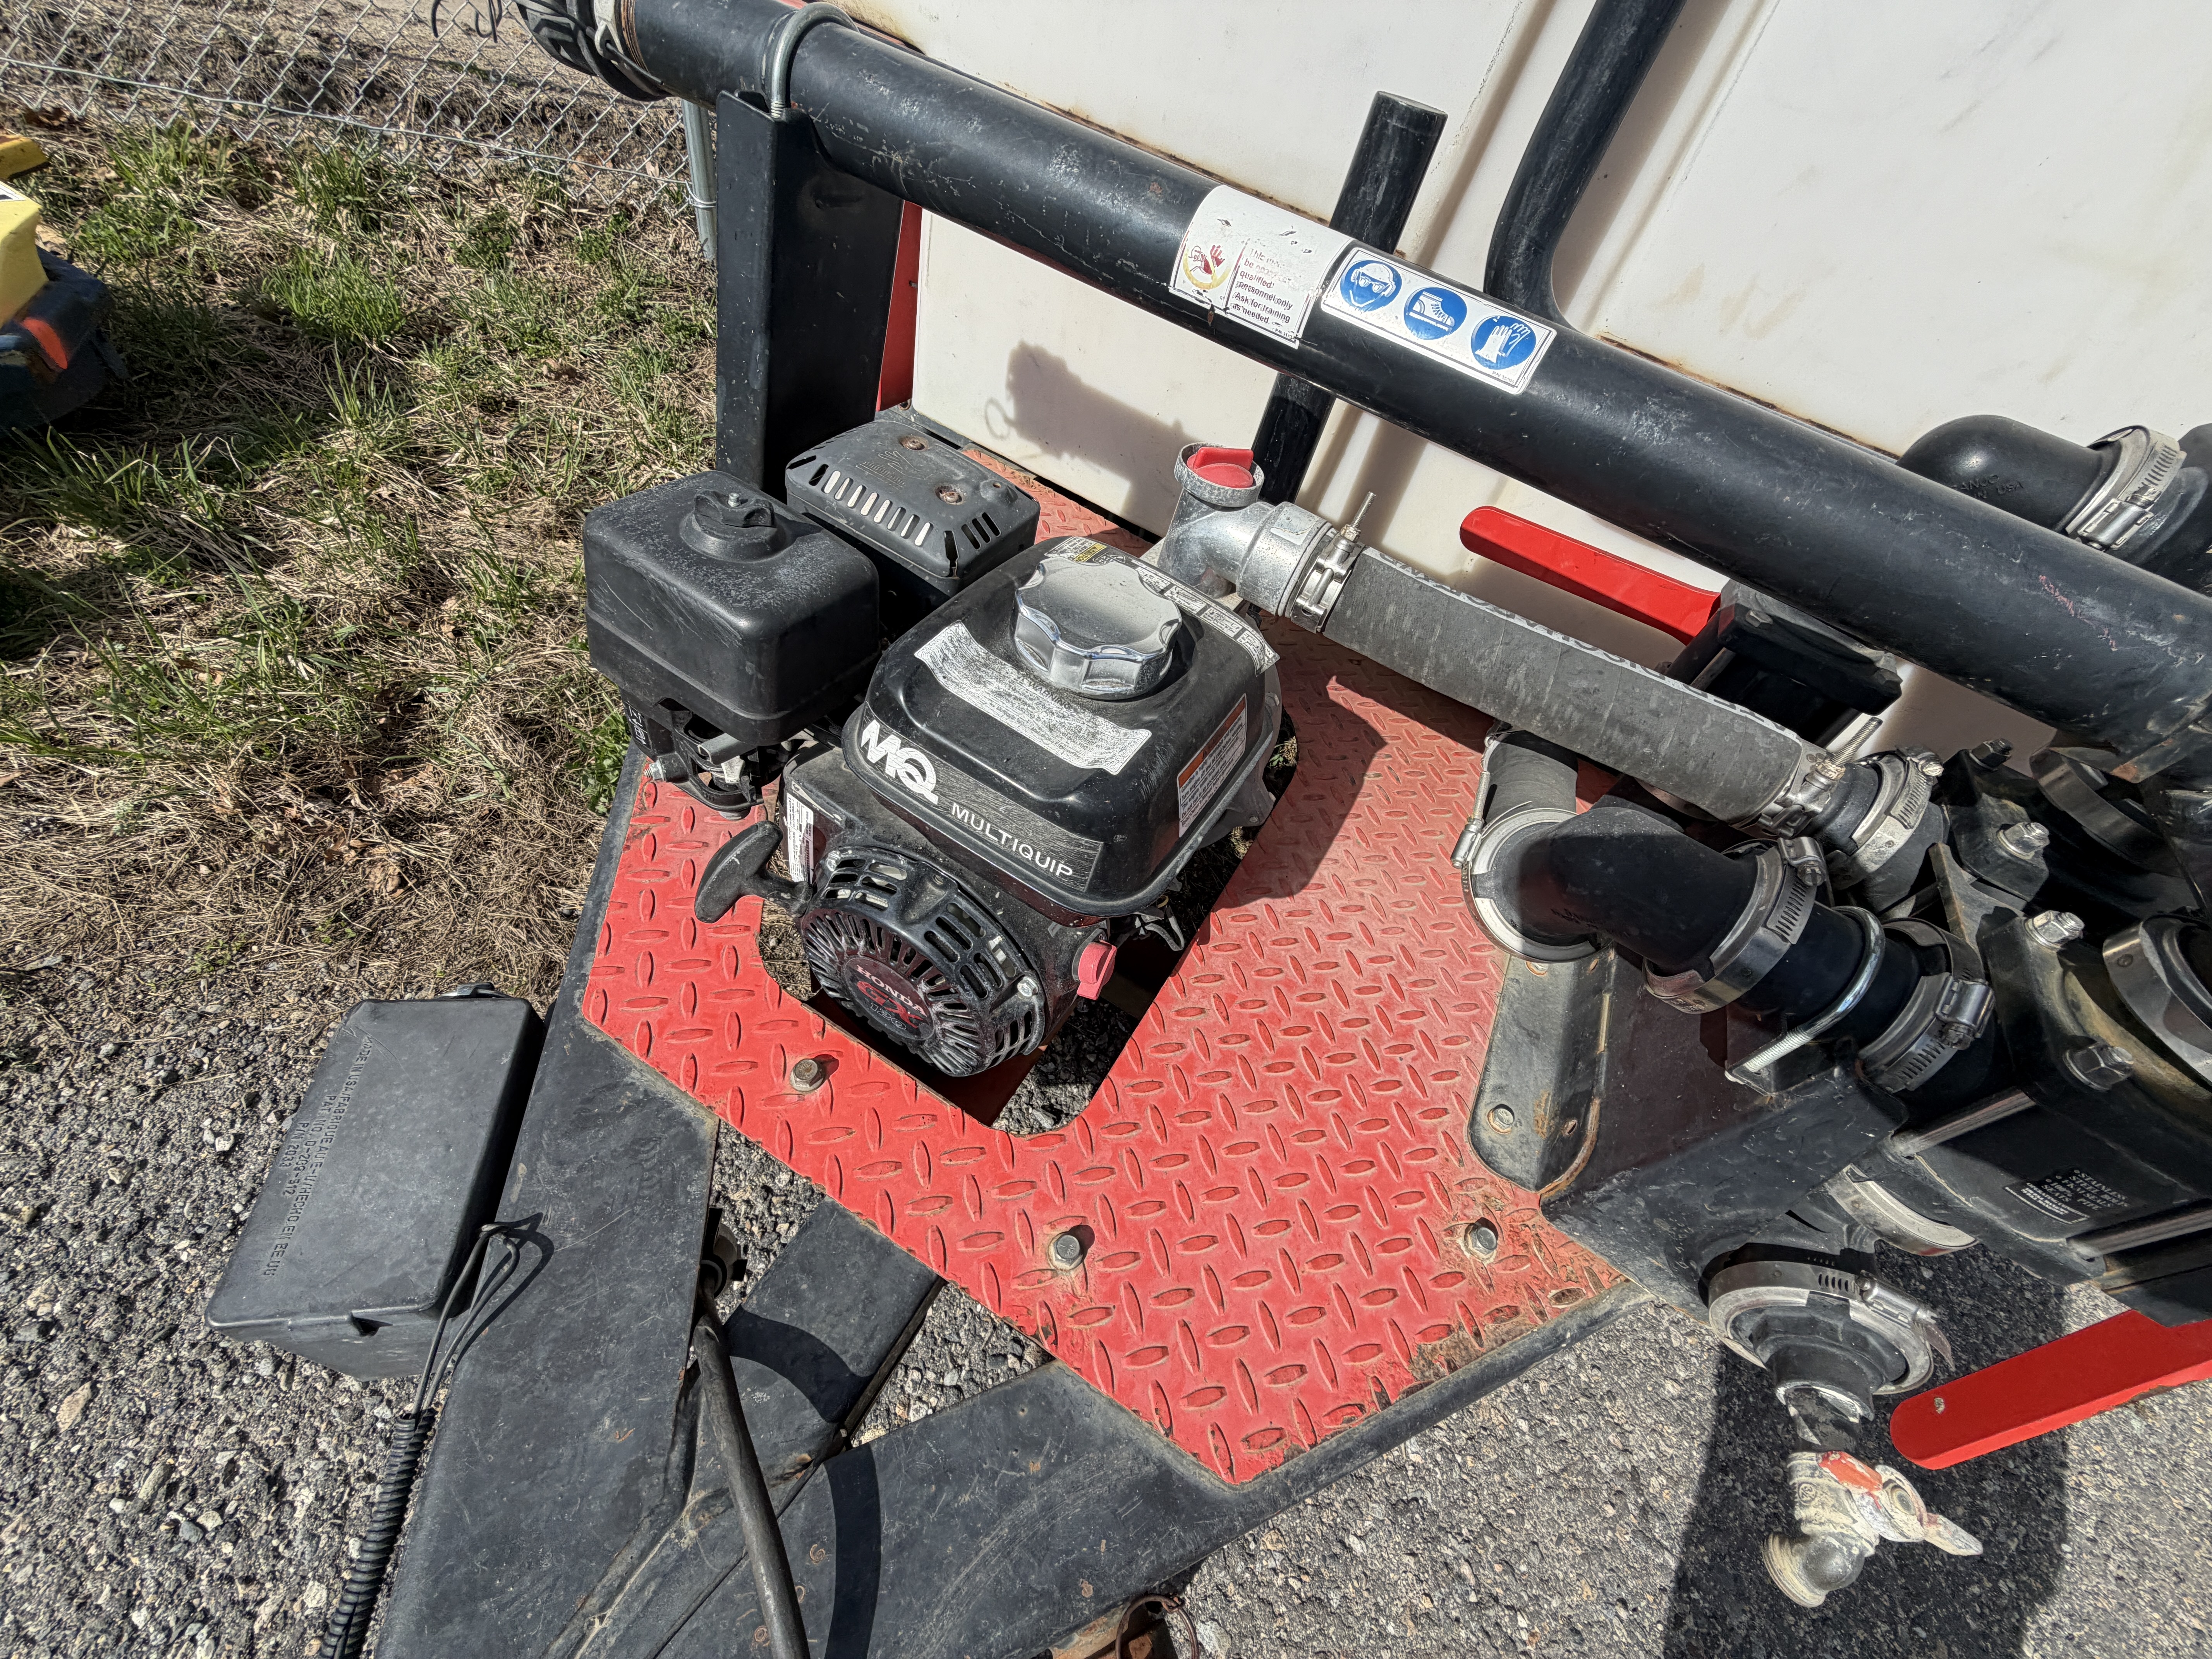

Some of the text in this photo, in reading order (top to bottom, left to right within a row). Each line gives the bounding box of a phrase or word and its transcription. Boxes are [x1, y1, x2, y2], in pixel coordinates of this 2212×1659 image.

[1235, 292, 1249, 303] Ask
[1262, 304, 1290, 323] training
[1236, 282, 1293, 310] personnel only
[861, 720, 938, 804] MQ
[951, 802, 1073, 876] MULTIQUIP
[856, 965, 927, 1017] HONDA
[857, 981, 924, 1029] GX
[871, 1002, 907, 1030] 120
[350, 1064, 364, 1072] IN
[311, 1120, 326, 1135] NO.
[280, 1122, 309, 1168] P/N 2033
[314, 1146, 329, 1159] AU
[2041, 1184, 2072, 1202] SEATS
[2069, 1176, 2099, 1194] STEEL
[2078, 1173, 2128, 1200] STAINLESS
